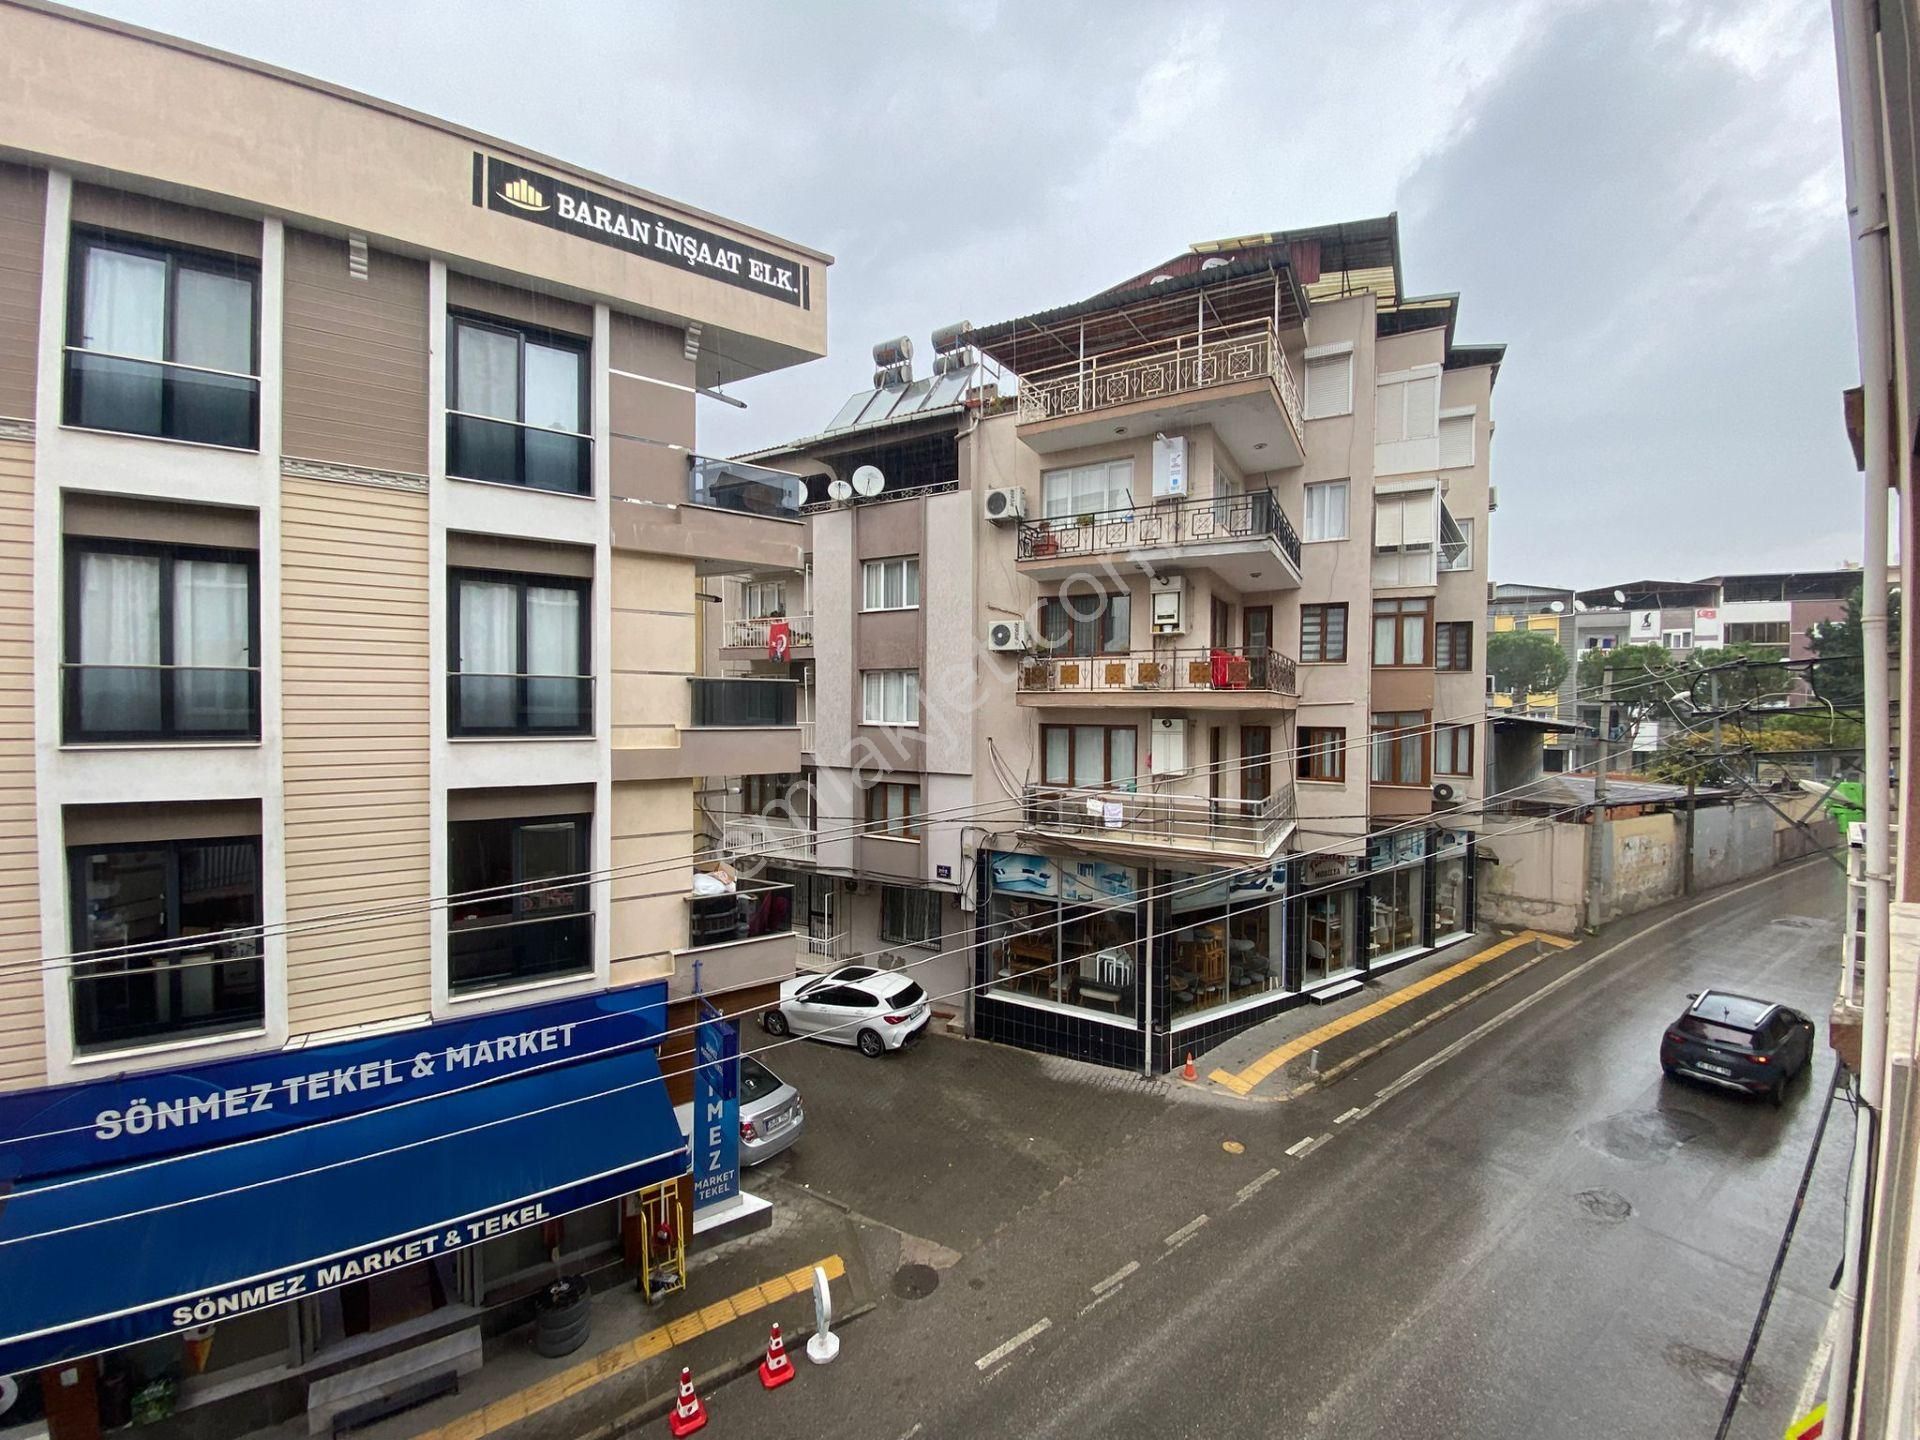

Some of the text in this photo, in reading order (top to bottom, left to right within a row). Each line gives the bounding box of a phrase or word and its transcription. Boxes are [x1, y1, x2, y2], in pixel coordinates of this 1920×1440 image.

[557, 193, 799, 293] BARAN İNŞAAT ELK.
[95, 1023, 576, 1140] SÖNMEZ TEKEL & MARKET
[694, 1170, 735, 1192] MARKET
[699, 1183, 730, 1201] TEKEL
[173, 1202, 550, 1326] SÖNMEZ MARKET & TEKEL
